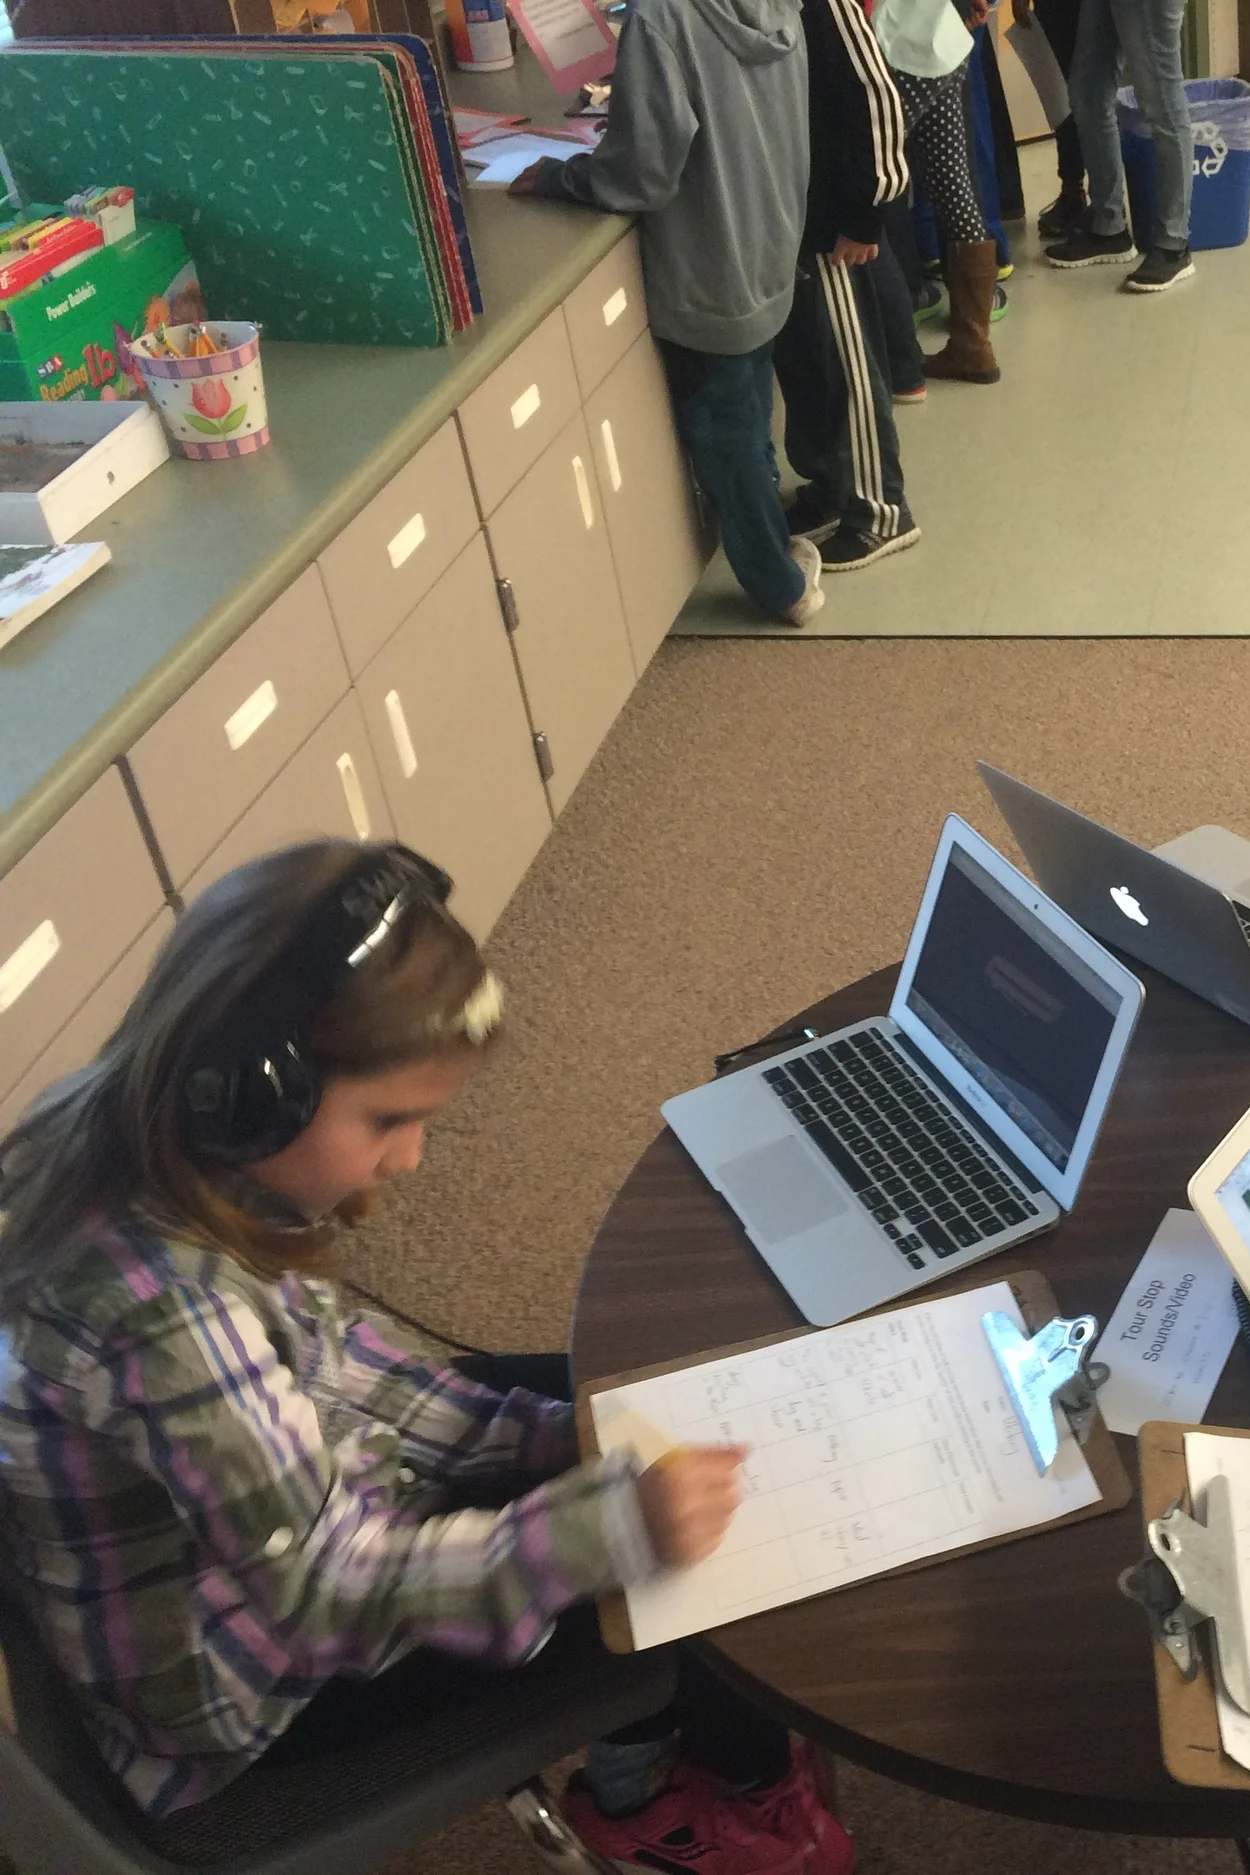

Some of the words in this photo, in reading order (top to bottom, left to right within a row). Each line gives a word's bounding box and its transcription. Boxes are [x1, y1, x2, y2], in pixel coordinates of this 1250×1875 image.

[1120, 1306, 1148, 1342] Tour
[1136, 1279, 1166, 1309] Stop
[1141, 1273, 1196, 1362] Sounds/Video
